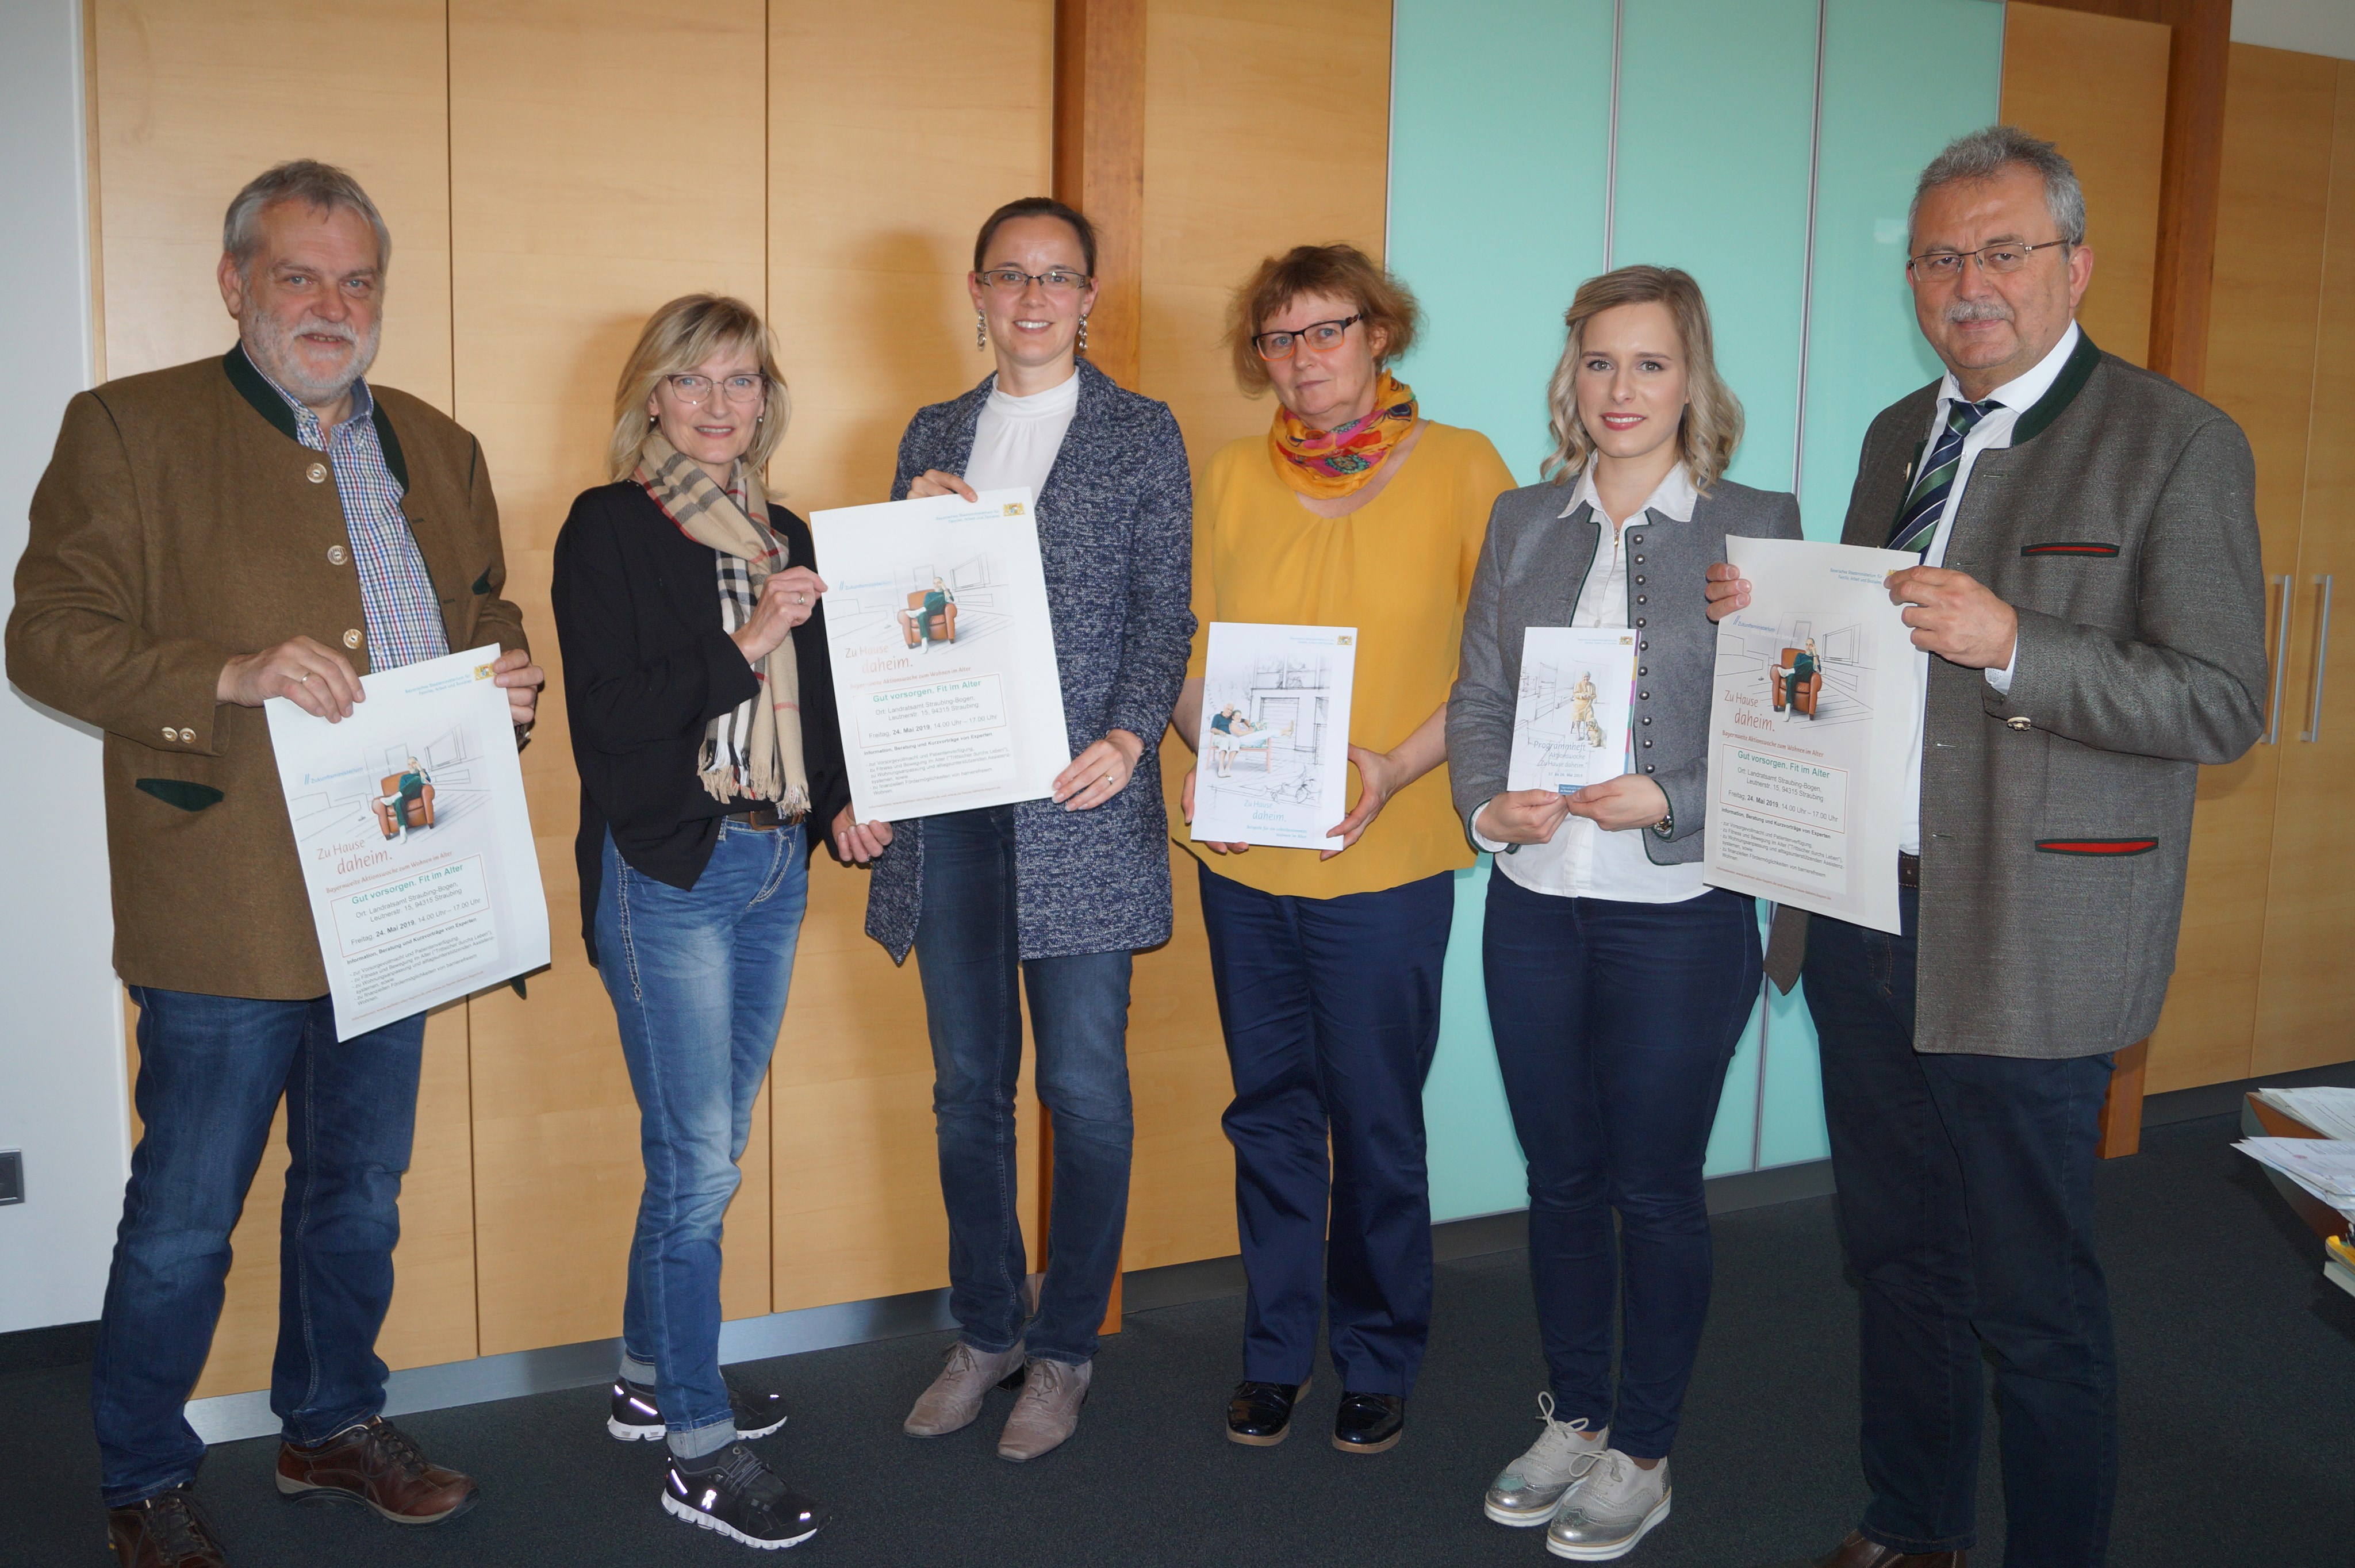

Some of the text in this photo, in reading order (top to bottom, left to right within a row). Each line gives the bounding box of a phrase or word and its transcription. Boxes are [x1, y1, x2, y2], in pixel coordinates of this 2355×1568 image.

[845, 645, 888, 658] Zu Hause
[862, 655, 913, 674] daheim.
[850, 681, 882, 689] Bayernweite
[883, 674, 918, 684] Aktionswoche
[888, 703, 924, 713] Landratsamt
[925, 696, 975, 707] Straubing-Bogen,
[890, 689, 934, 699] vorsorgen.
[1724, 690, 1758, 707] Zu Hause
[888, 712, 917, 720] Leutnerstr.
[1735, 708, 1774, 731] daheim.
[1533, 741, 1586, 753] Programmheft
[1723, 730, 1748, 741] Bayernweite
[1748, 736, 1777, 747] Aktionswoche
[1787, 745, 1805, 753] Wohnen
[1548, 760, 1563, 768] Hause
[1738, 750, 1829, 778] Gut vorsorgen. Fit im Alter
[1747, 769, 1777, 782] Landratsamt
[1778, 776, 1821, 792] Straubing-Bogen,
[1747, 777, 1771, 788] Leutnerstr.
[1782, 786, 1798, 795] 94315
[1799, 790, 1823, 803] Straubing
[1253, 800, 1272, 808] Hause
[1728, 790, 1746, 800] Freitag,
[1766, 799, 1779, 808] 2019,
[1782, 803, 1796, 812] 14.00
[1813, 811, 1827, 819] 17.00
[1252, 810, 1286, 822] daheim.
[1721, 807, 1744, 818] Information,
[1746, 814, 1764, 823] Beratung
[1774, 821, 1801, 832] Kurzvorträge
[1811, 830, 1831, 839] Experten
[317, 839, 365, 860] Zu Hause
[337, 850, 392, 875] daheim.
[326, 879, 360, 894] Bayernweite
[362, 868, 398, 882] Aktionswoche
[411, 858, 432, 867] Wohnen
[352, 894, 368, 904] Gut
[370, 881, 416, 898] vorsorgen.
[419, 875, 429, 883] Fit
[444, 865, 462, 876] Alter
[369, 898, 407, 914] Landratsamt
[408, 882, 458, 902] Straubing-Bogen,
[370, 908, 401, 922] Leutnerstr.
[415, 897, 433, 908] 94315
[435, 888, 462, 901] Straubing
[351, 935, 374, 945] Freitag,
[400, 920, 416, 929] 2019,
[418, 913, 434, 922] 14.00
[453, 902, 469, 911] 17.00
[347, 952, 378, 964] Information,
[378, 944, 401, 954] Beratung
[413, 929, 444, 942] Kurzvorträge
[455, 918, 477, 927] Experten
